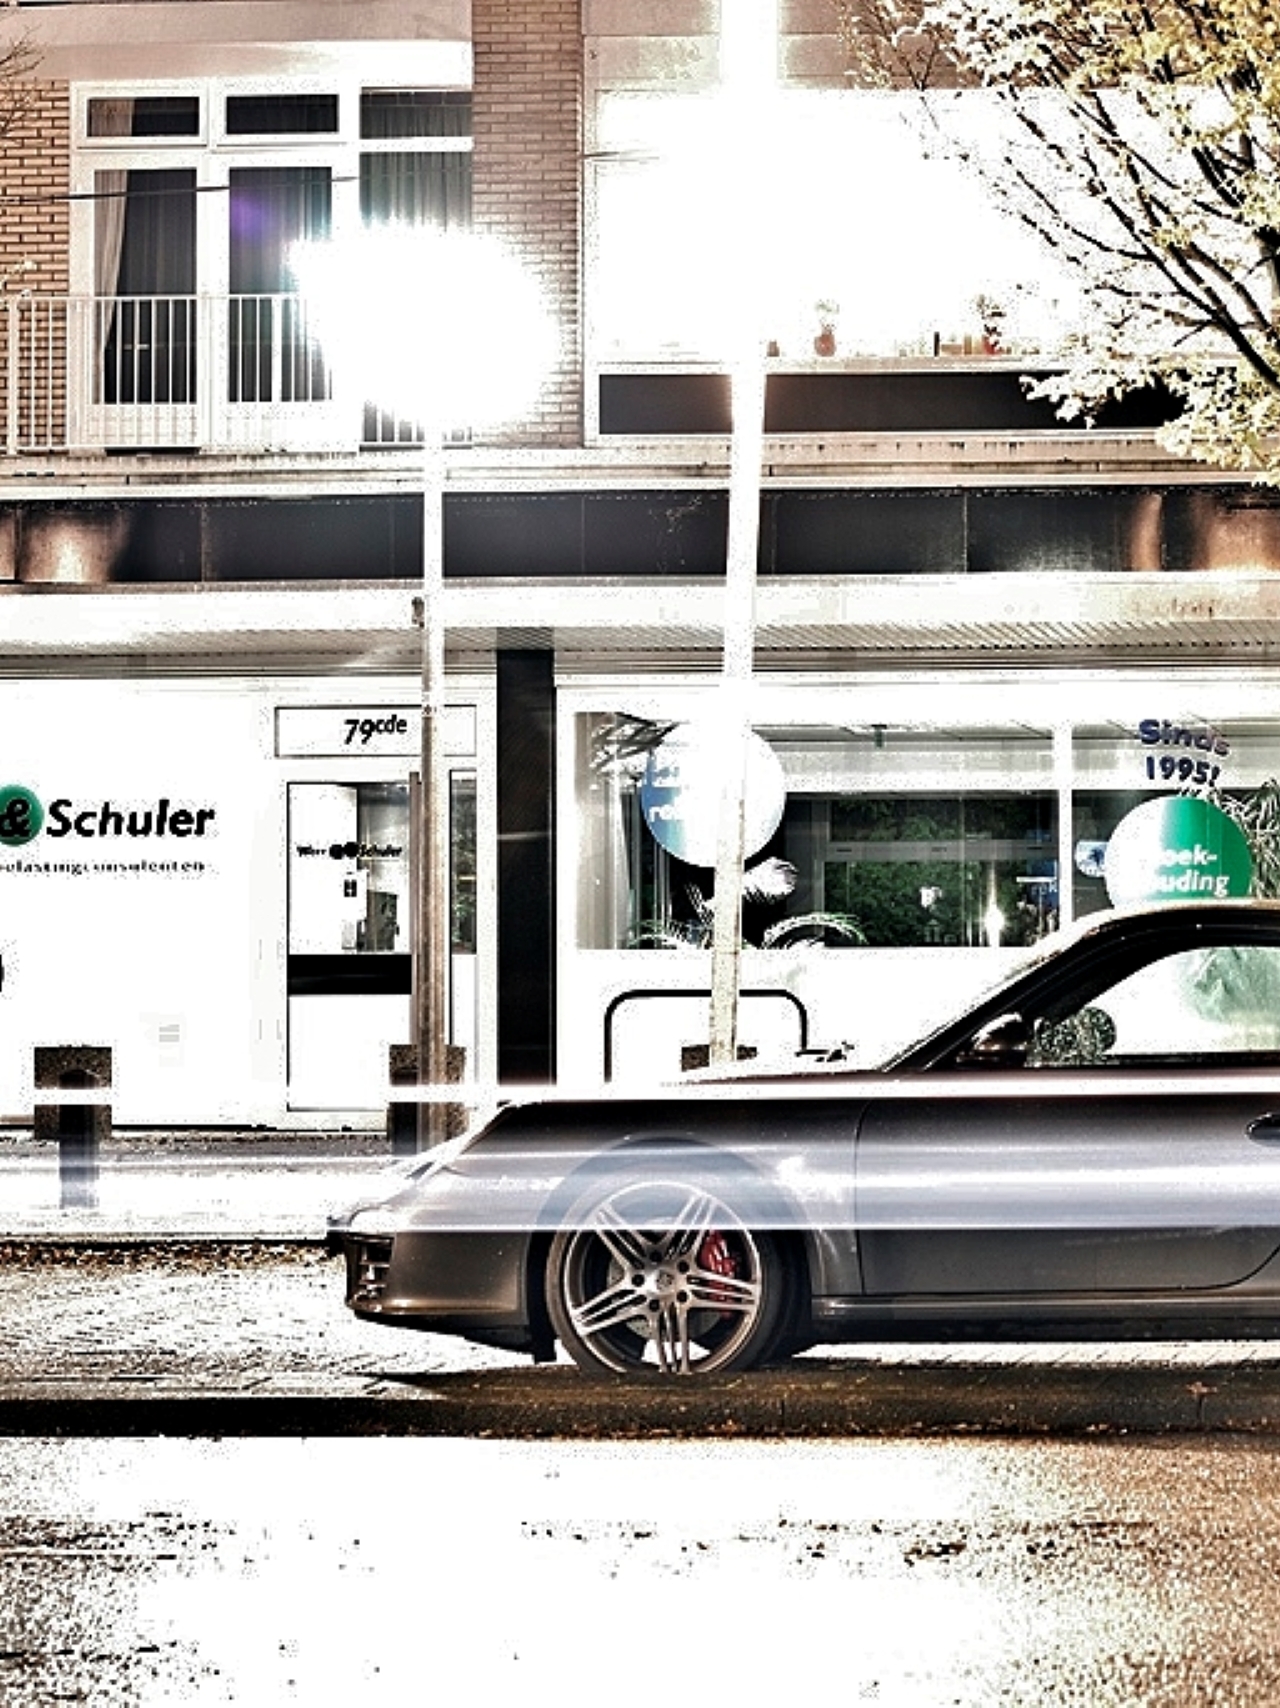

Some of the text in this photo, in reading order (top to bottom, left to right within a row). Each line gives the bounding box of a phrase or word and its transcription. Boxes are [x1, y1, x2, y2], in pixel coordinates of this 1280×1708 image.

[1138, 719, 1231, 756] Sinds
[1146, 755, 1221, 787] 1995!
[46, 798, 216, 838] Schuler
[1154, 843, 1218, 867] oek-
